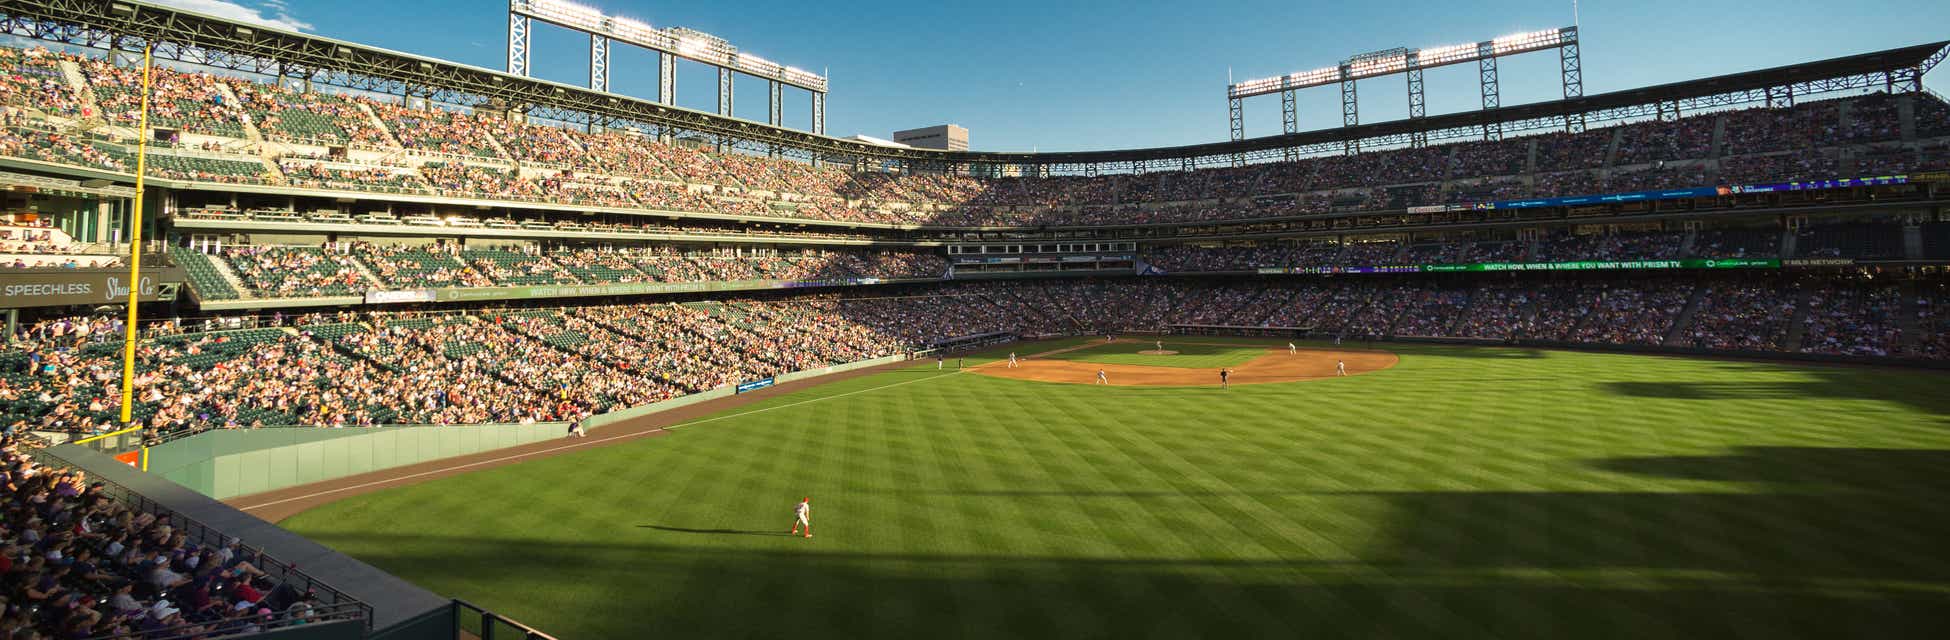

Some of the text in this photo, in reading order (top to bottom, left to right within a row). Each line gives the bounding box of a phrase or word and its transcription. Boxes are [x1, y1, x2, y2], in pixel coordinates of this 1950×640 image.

[1484, 263, 1507, 271] WATCH
[1555, 262, 1580, 270] WHERE
[1581, 261, 1597, 269] YOU
[1597, 261, 1620, 269] WANT
[1621, 261, 1642, 269] WITH
[1643, 261, 1669, 269] PRISM
